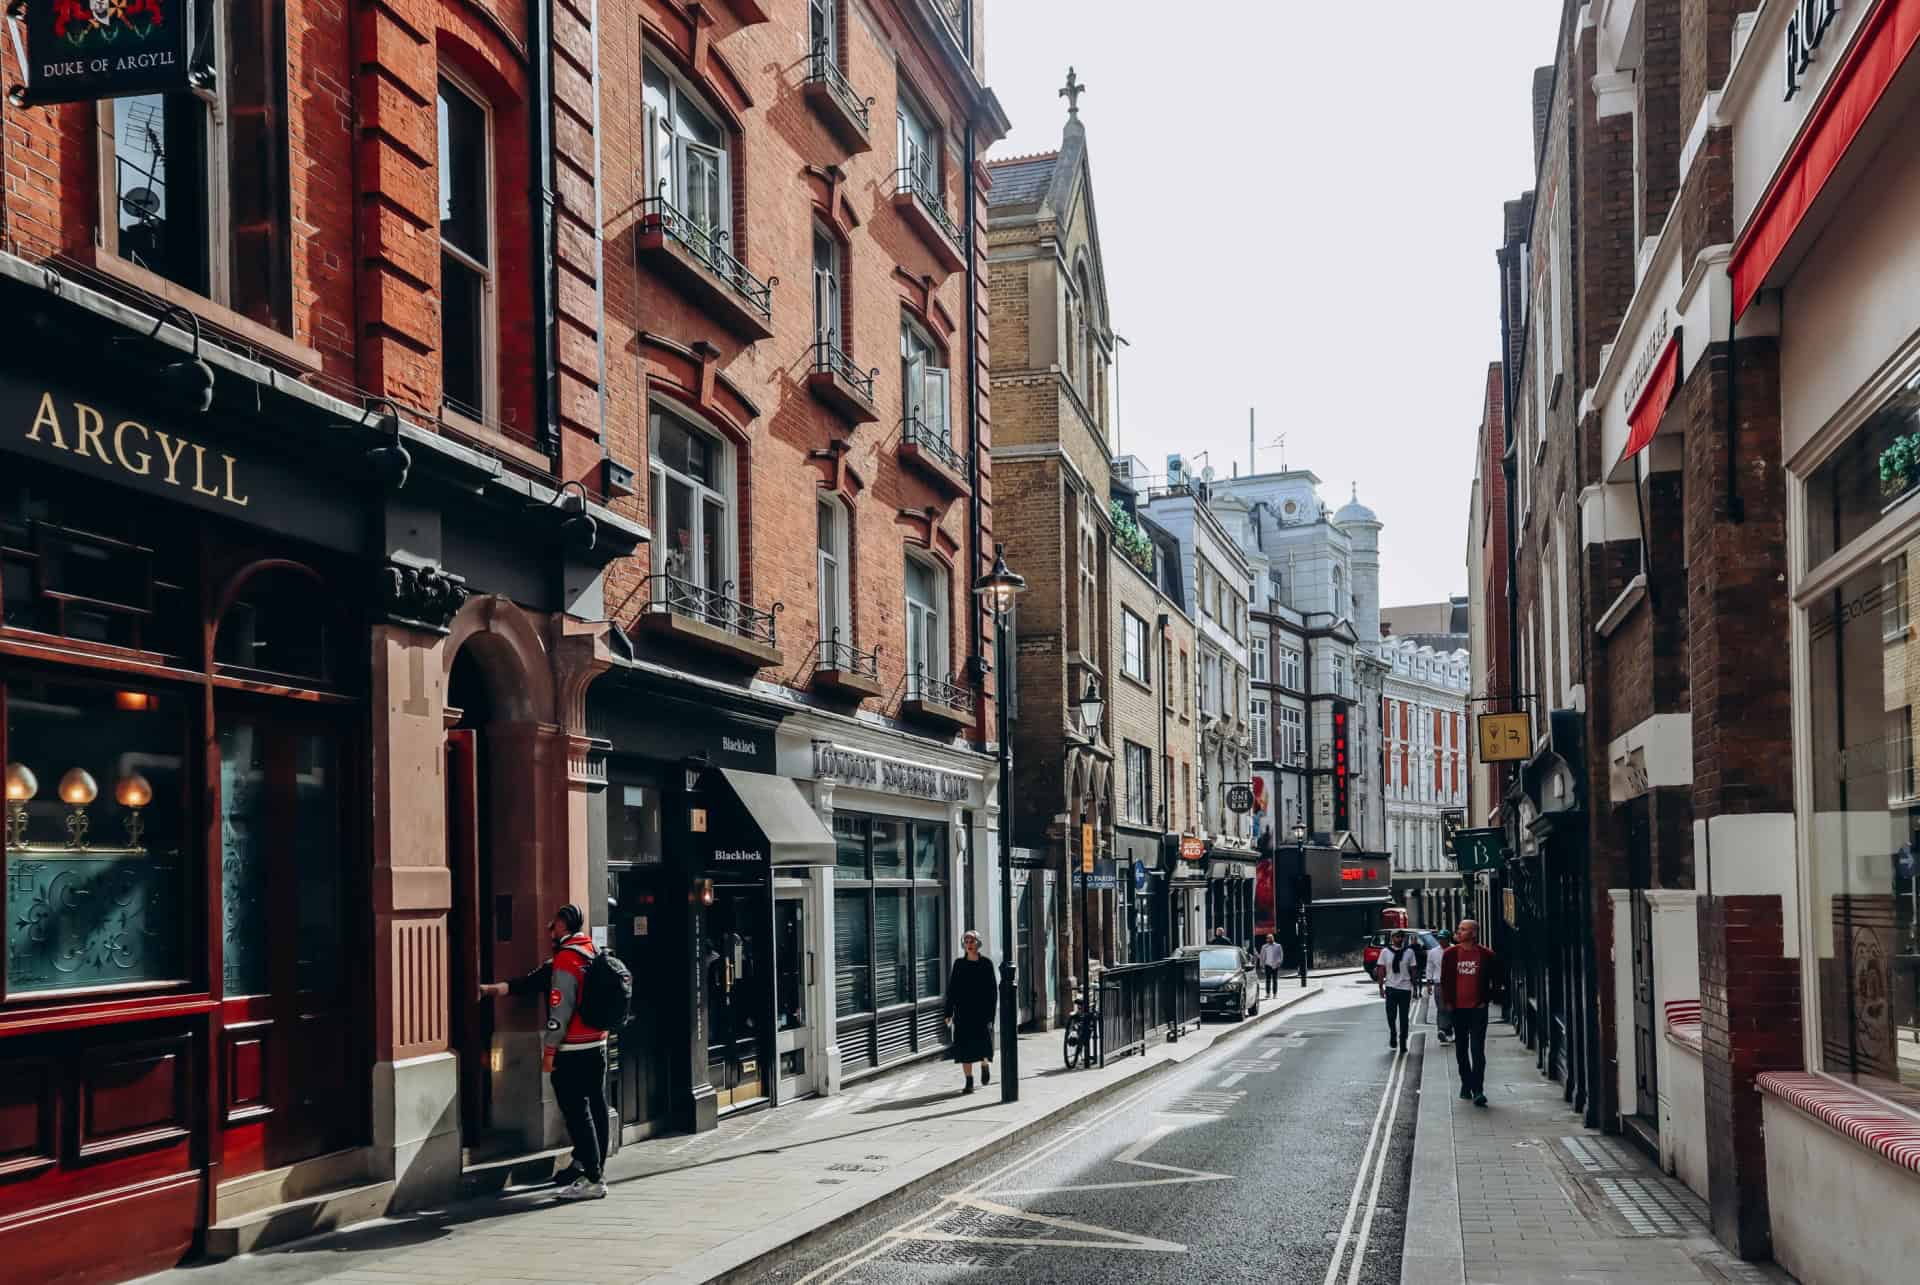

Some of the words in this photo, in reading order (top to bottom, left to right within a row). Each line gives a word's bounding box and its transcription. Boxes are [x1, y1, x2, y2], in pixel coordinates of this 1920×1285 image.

[43, 61, 84, 77] DUKE
[90, 58, 110, 73] OF
[116, 51, 176, 70] ARGYLL
[25, 391, 249, 506] ARGYLL
[722, 736, 757, 755] Blacklock
[715, 850, 762, 861] Blacklock
